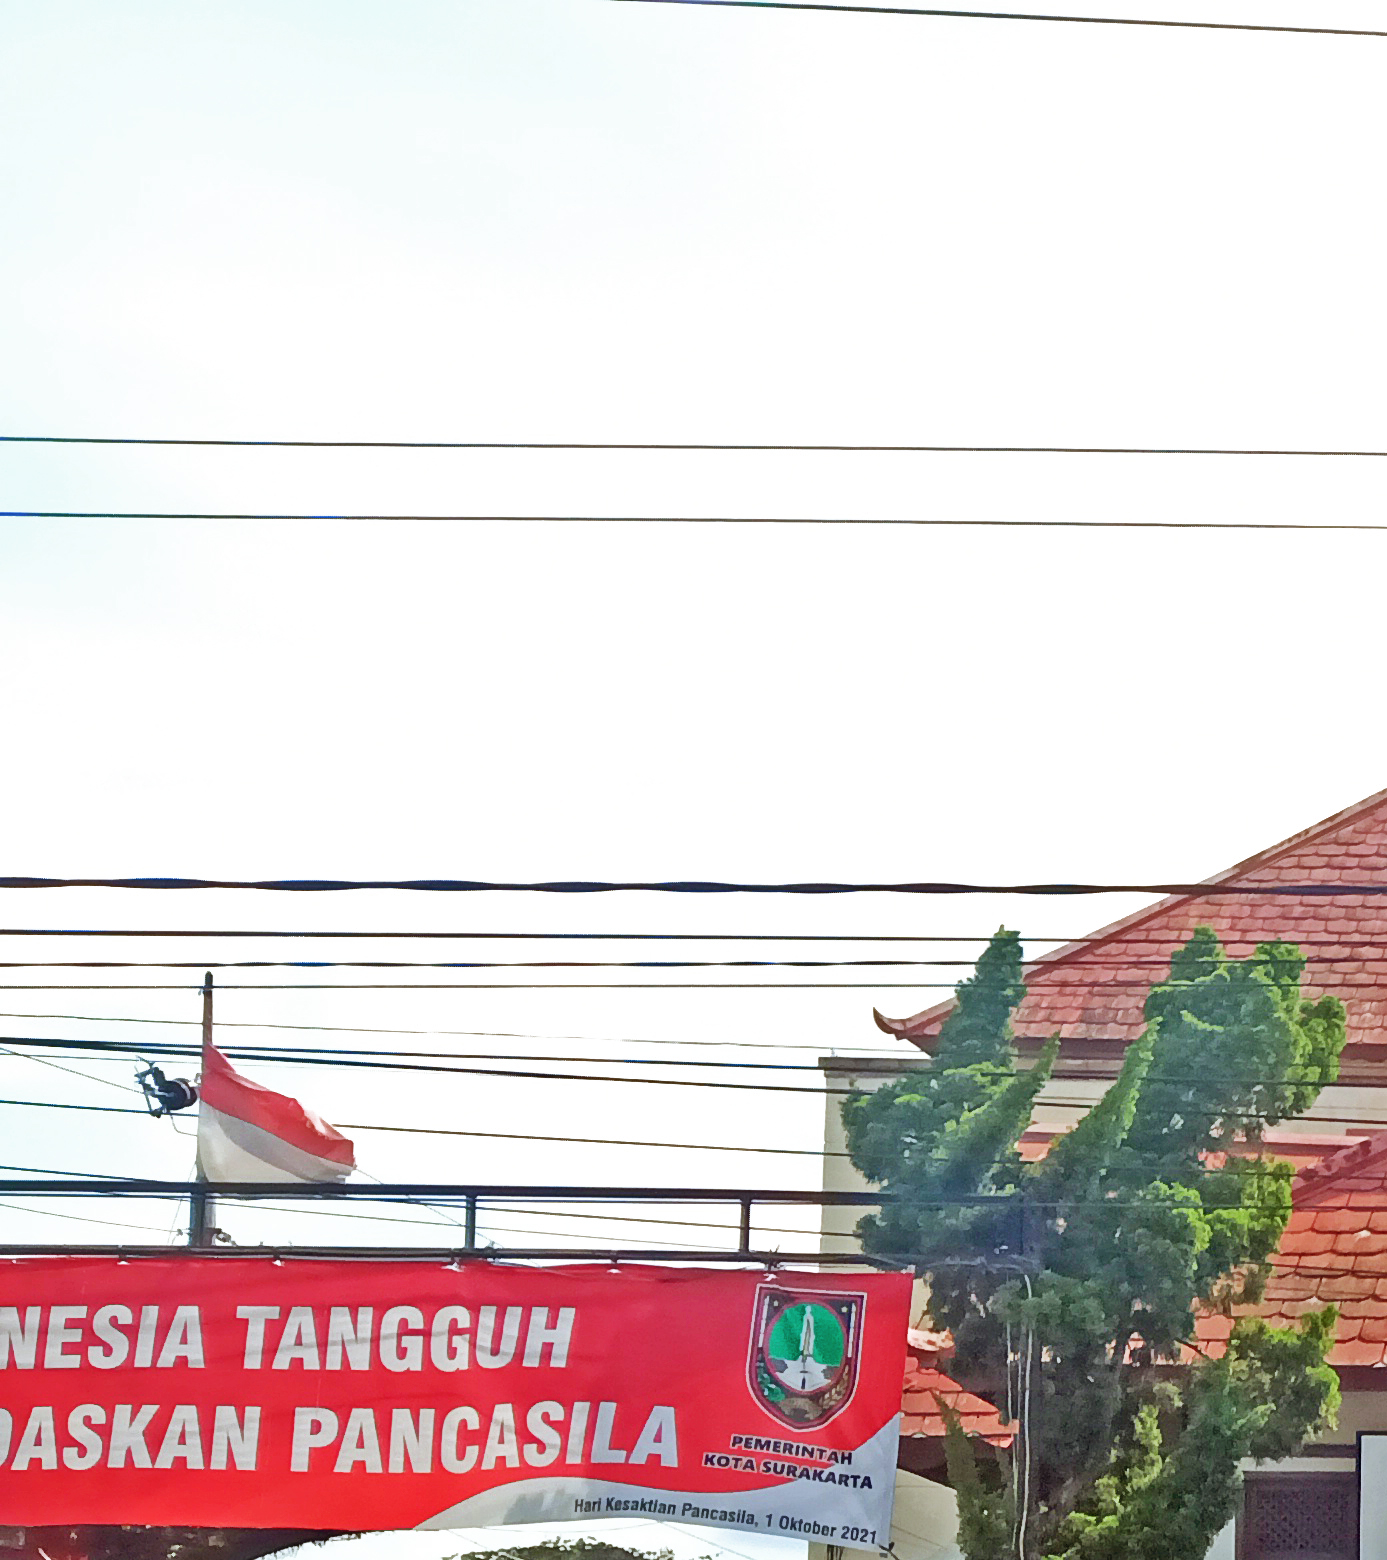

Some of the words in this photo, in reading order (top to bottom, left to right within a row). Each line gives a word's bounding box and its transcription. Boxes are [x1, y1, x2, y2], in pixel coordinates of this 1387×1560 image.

[236, 1304, 576, 1372] TANGGUH
[290, 1400, 679, 1474] PANCASILA
[730, 1435, 853, 1465] PEMERINTAH
[703, 1453, 755, 1472] KOTA
[761, 1461, 873, 1489] SURAKARTA
[574, 1498, 601, 1513] Hari
[605, 1497, 677, 1516] Kesaktian
[681, 1502, 759, 1528] Pancasila,
[765, 1515, 773, 1528] 1
[778, 1515, 837, 1537] Oktober
[840, 1525, 878, 1545] 2021
